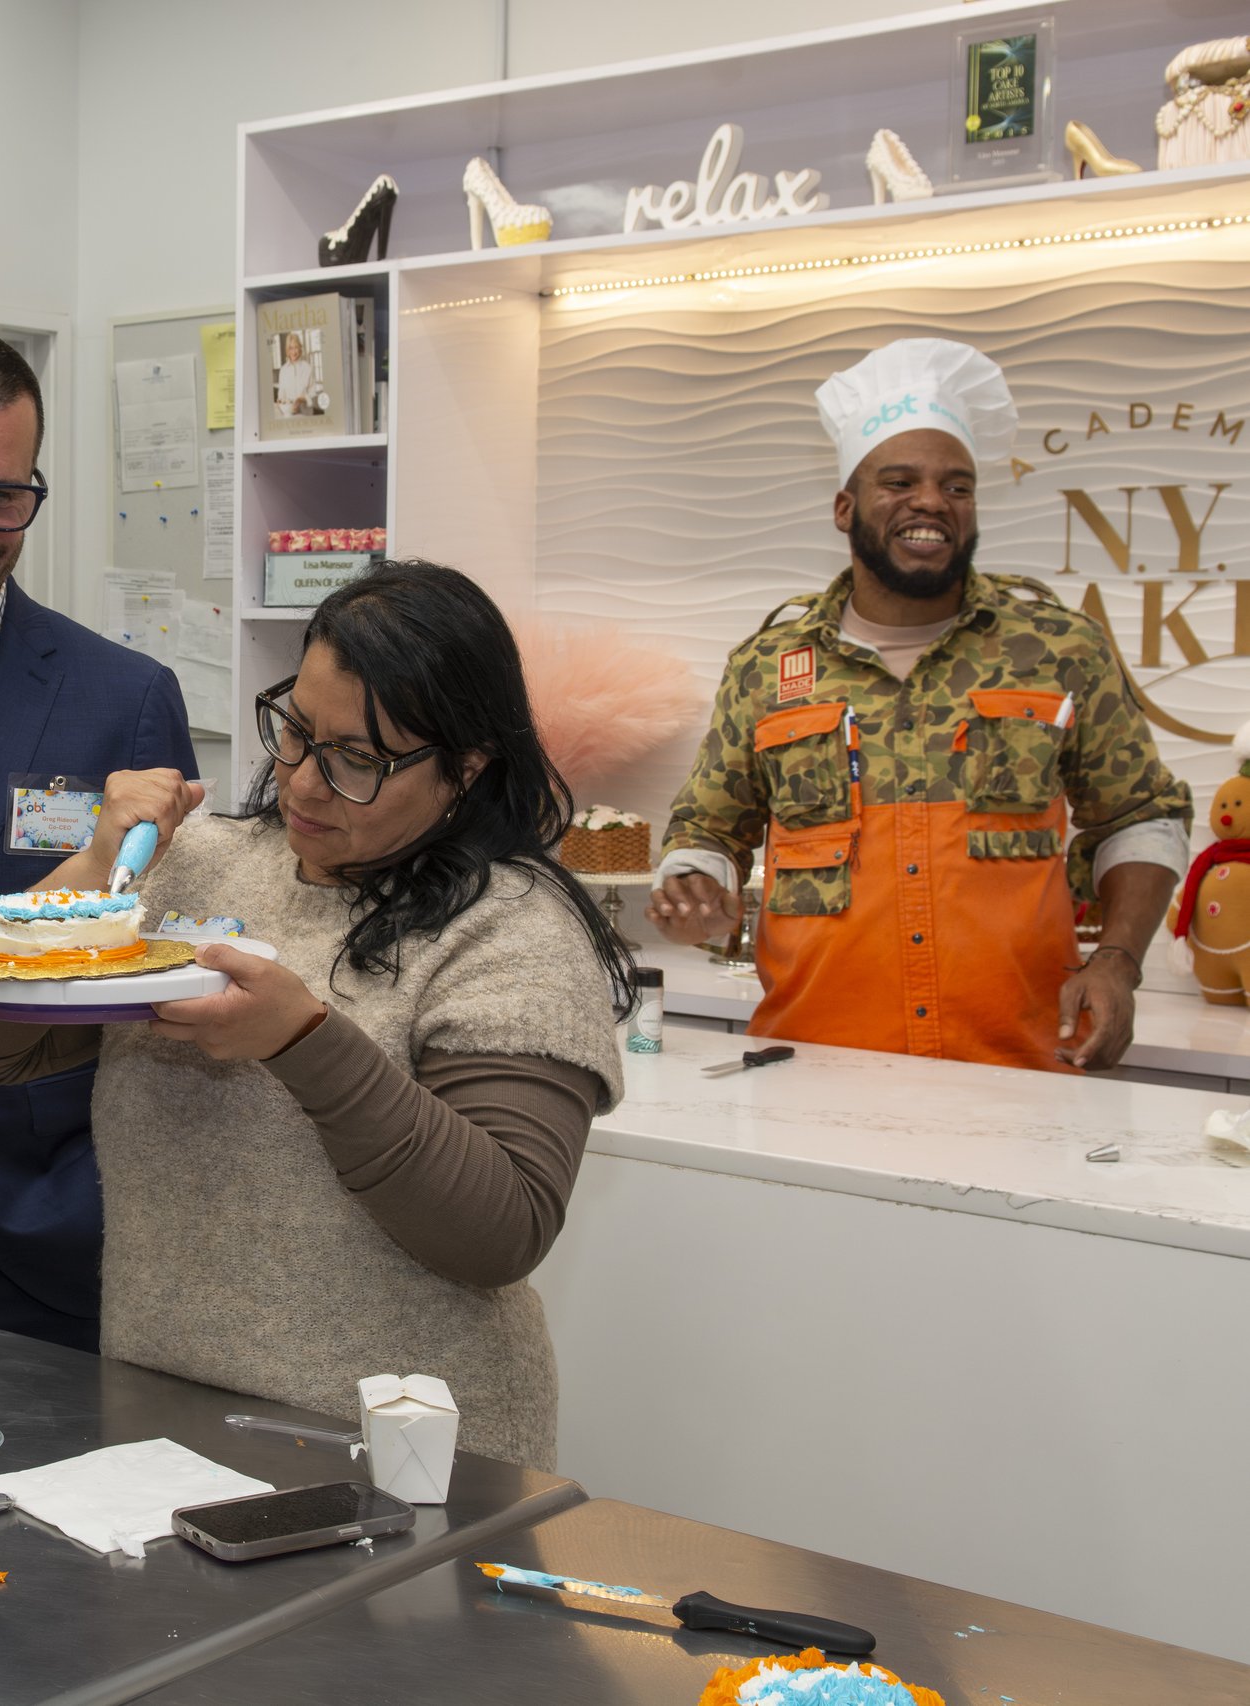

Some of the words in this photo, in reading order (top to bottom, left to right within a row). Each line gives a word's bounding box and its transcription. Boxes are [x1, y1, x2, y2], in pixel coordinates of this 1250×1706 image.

[989, 66, 1011, 80] TOP
[992, 78, 1019, 91] CAKE
[989, 87, 1026, 102] ARTISTS
[624, 123, 829, 234] relax
[262, 303, 327, 331] Martha
[861, 394, 918, 436] obt
[1055, 483, 1232, 574] N.Y.
[303, 560, 319, 569] Lisa
[294, 578, 322, 588] QUEEN
[781, 678, 812, 692] MADE
[27, 802, 46, 813] obt
